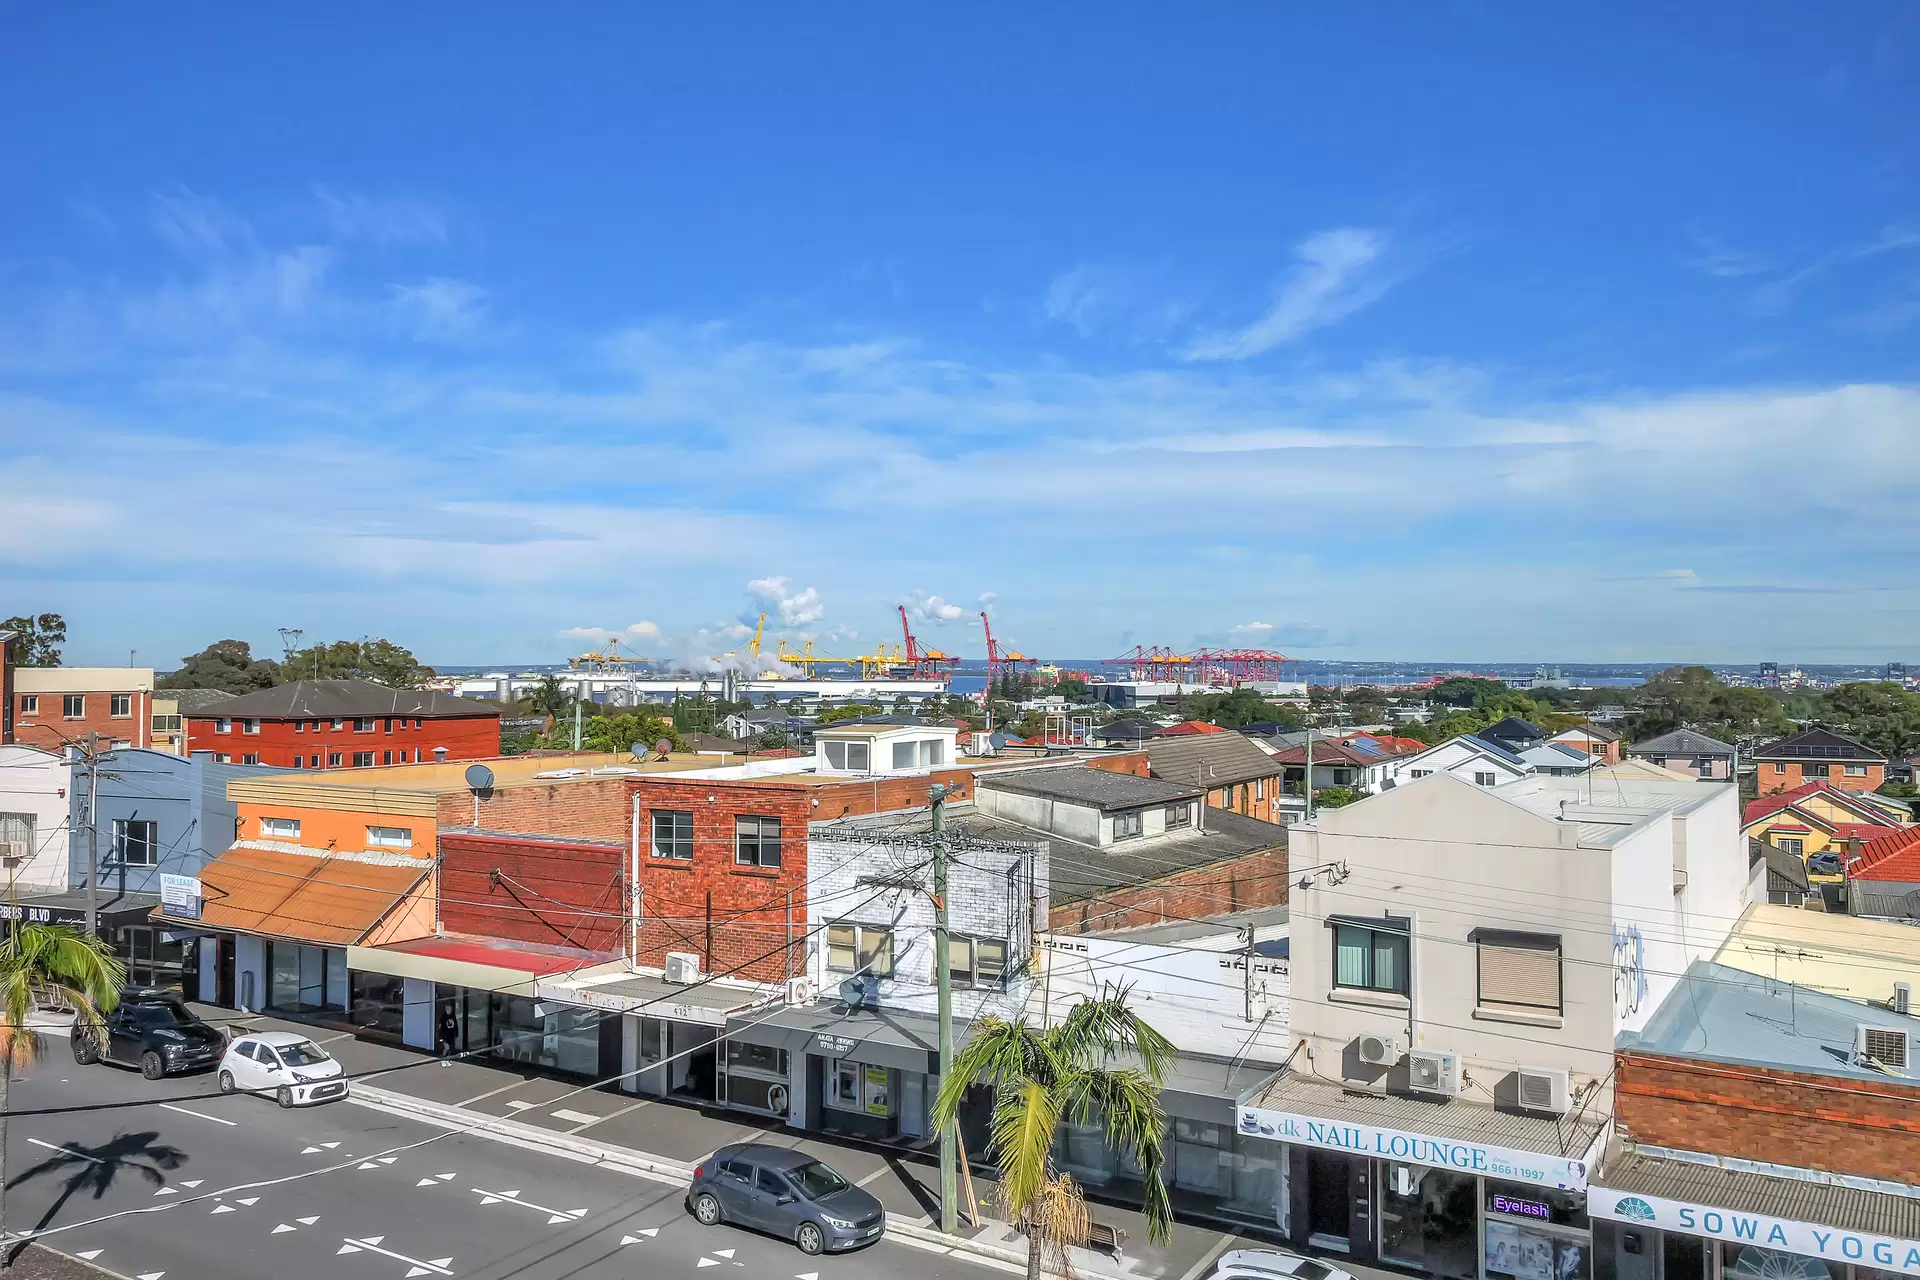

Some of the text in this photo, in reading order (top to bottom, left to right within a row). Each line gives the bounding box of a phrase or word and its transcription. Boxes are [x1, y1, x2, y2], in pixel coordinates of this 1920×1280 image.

[164, 876, 194, 888] FOR LEASE
[29, 908, 50, 922] BLVD
[1277, 1119, 1488, 1171] dk NAIL LOUNGE
[1491, 1163, 1518, 1177] 9661
[1520, 1168, 1545, 1180] 1997
[1495, 1197, 1549, 1217] Eyelash
[1679, 1208, 1920, 1268] SOWA YOGA
